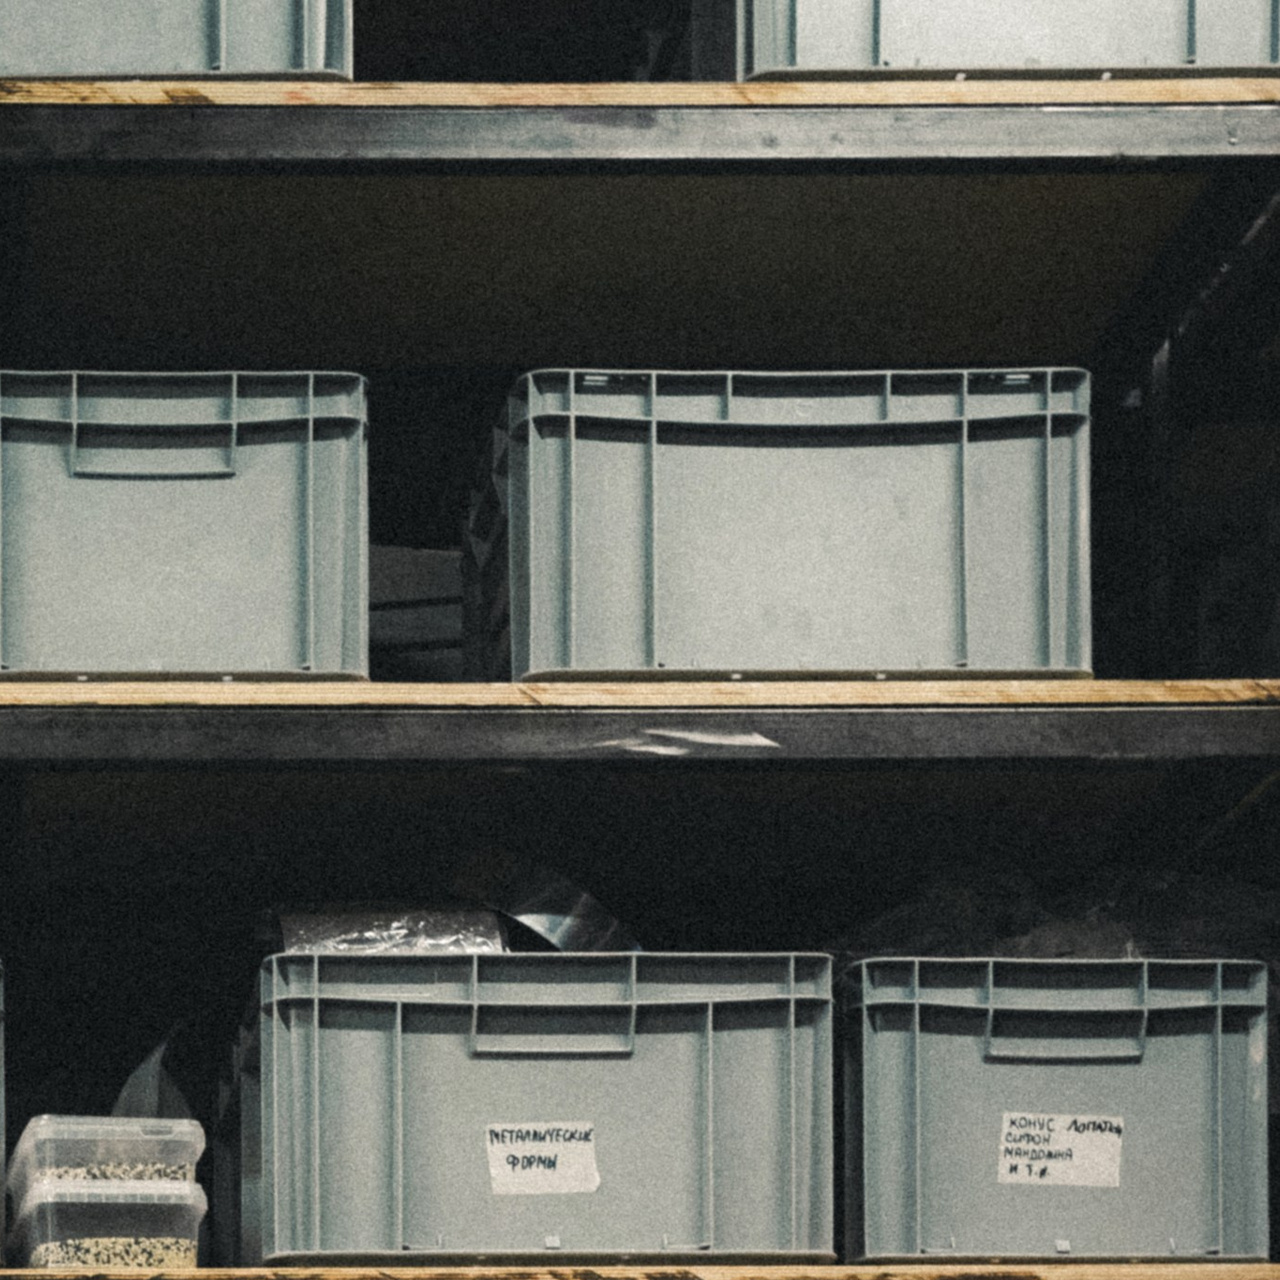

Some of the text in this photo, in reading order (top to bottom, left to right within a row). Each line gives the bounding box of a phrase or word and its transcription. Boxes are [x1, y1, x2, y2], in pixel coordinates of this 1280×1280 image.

[1008, 1117, 1055, 1132] КОНУС
[1005, 1131, 1051, 1145] СИФОН
[506, 1153, 558, 1172] ФОРМЫ
